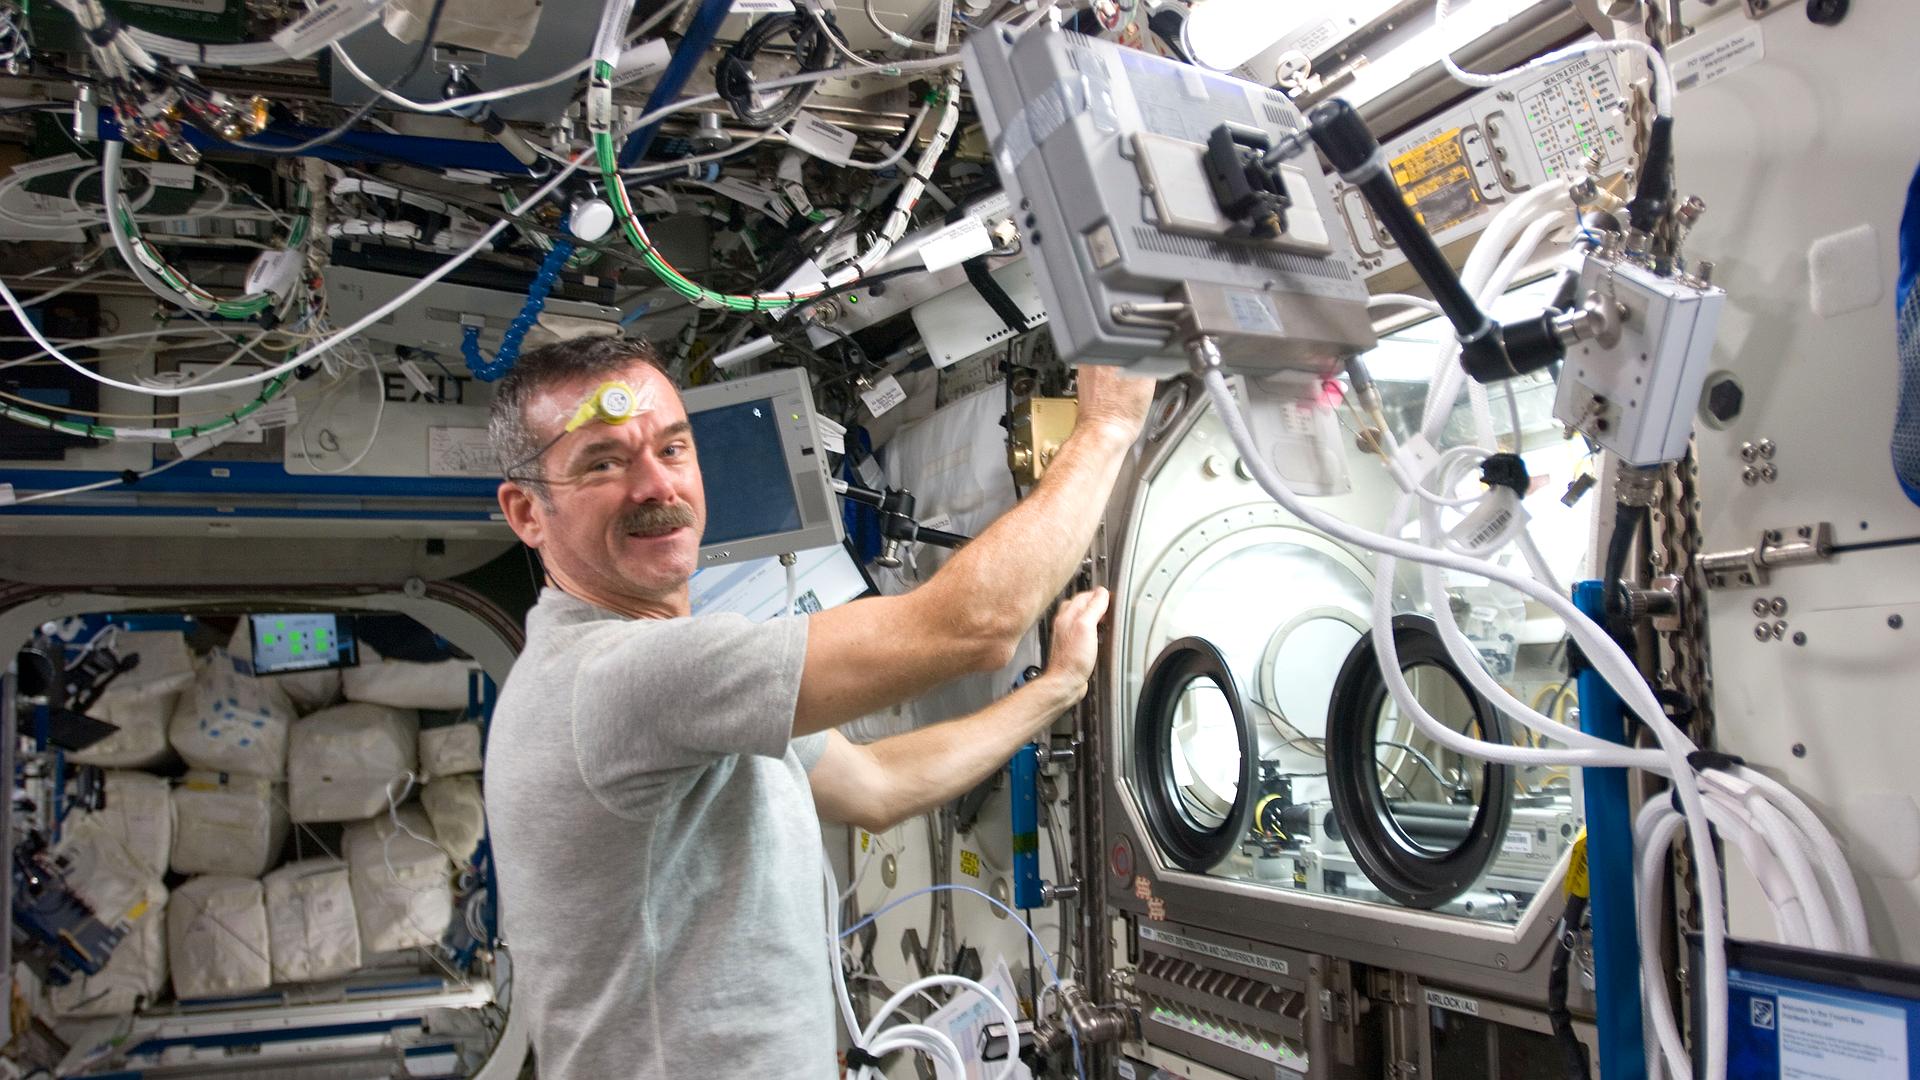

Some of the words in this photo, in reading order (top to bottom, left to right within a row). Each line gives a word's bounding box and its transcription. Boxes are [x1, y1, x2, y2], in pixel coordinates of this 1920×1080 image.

[1543, 72, 1563, 86] HEALTH
[1569, 59, 1591, 75] STATUS
[384, 373, 472, 405] EXIT
